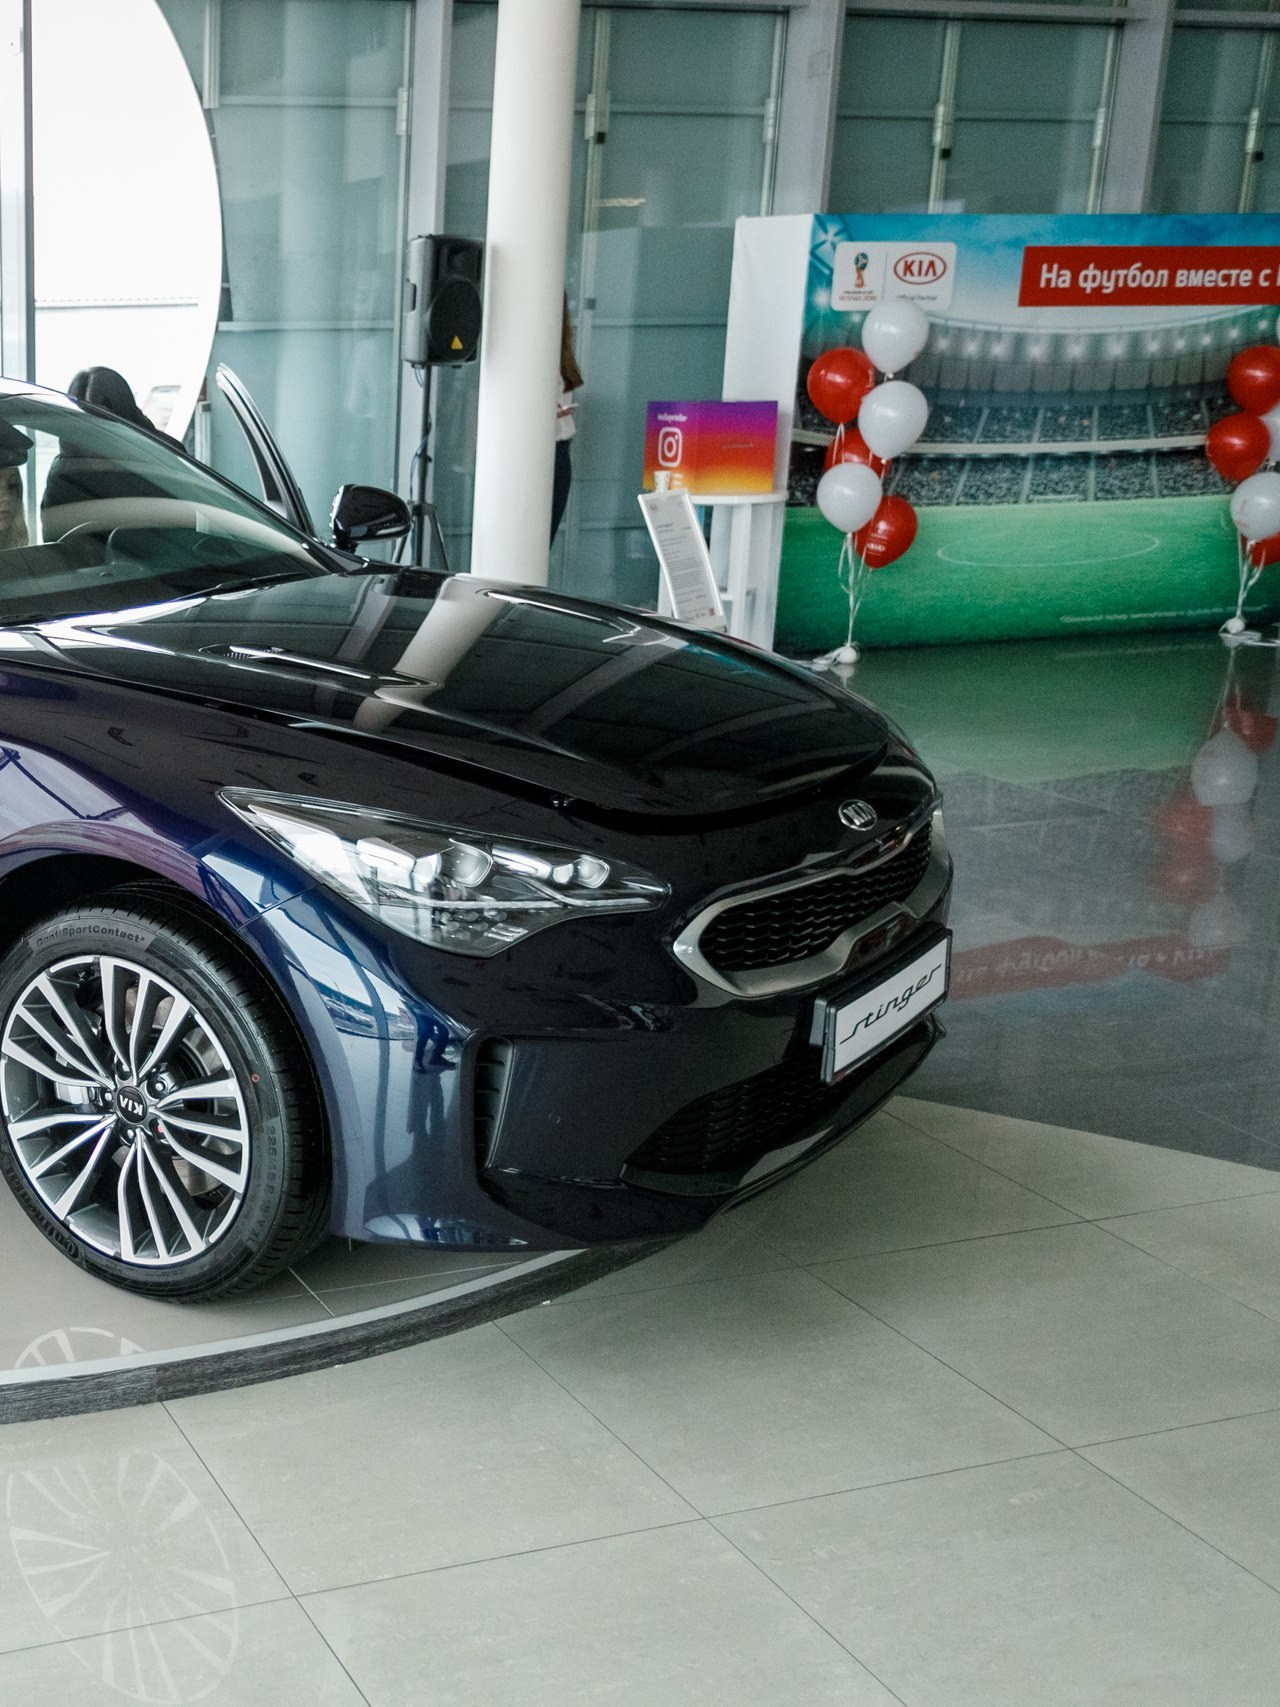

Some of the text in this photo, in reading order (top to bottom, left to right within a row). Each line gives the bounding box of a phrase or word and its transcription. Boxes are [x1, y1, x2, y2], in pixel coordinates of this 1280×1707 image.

[903, 260, 937, 277] KIA
[1040, 263, 1072, 288] На
[1078, 262, 1169, 294] футбол
[1175, 269, 1253, 288] вместе
[1258, 268, 1272, 287] с
[839, 964, 942, 1045] stinger
[119, 1094, 143, 1116] KIA
